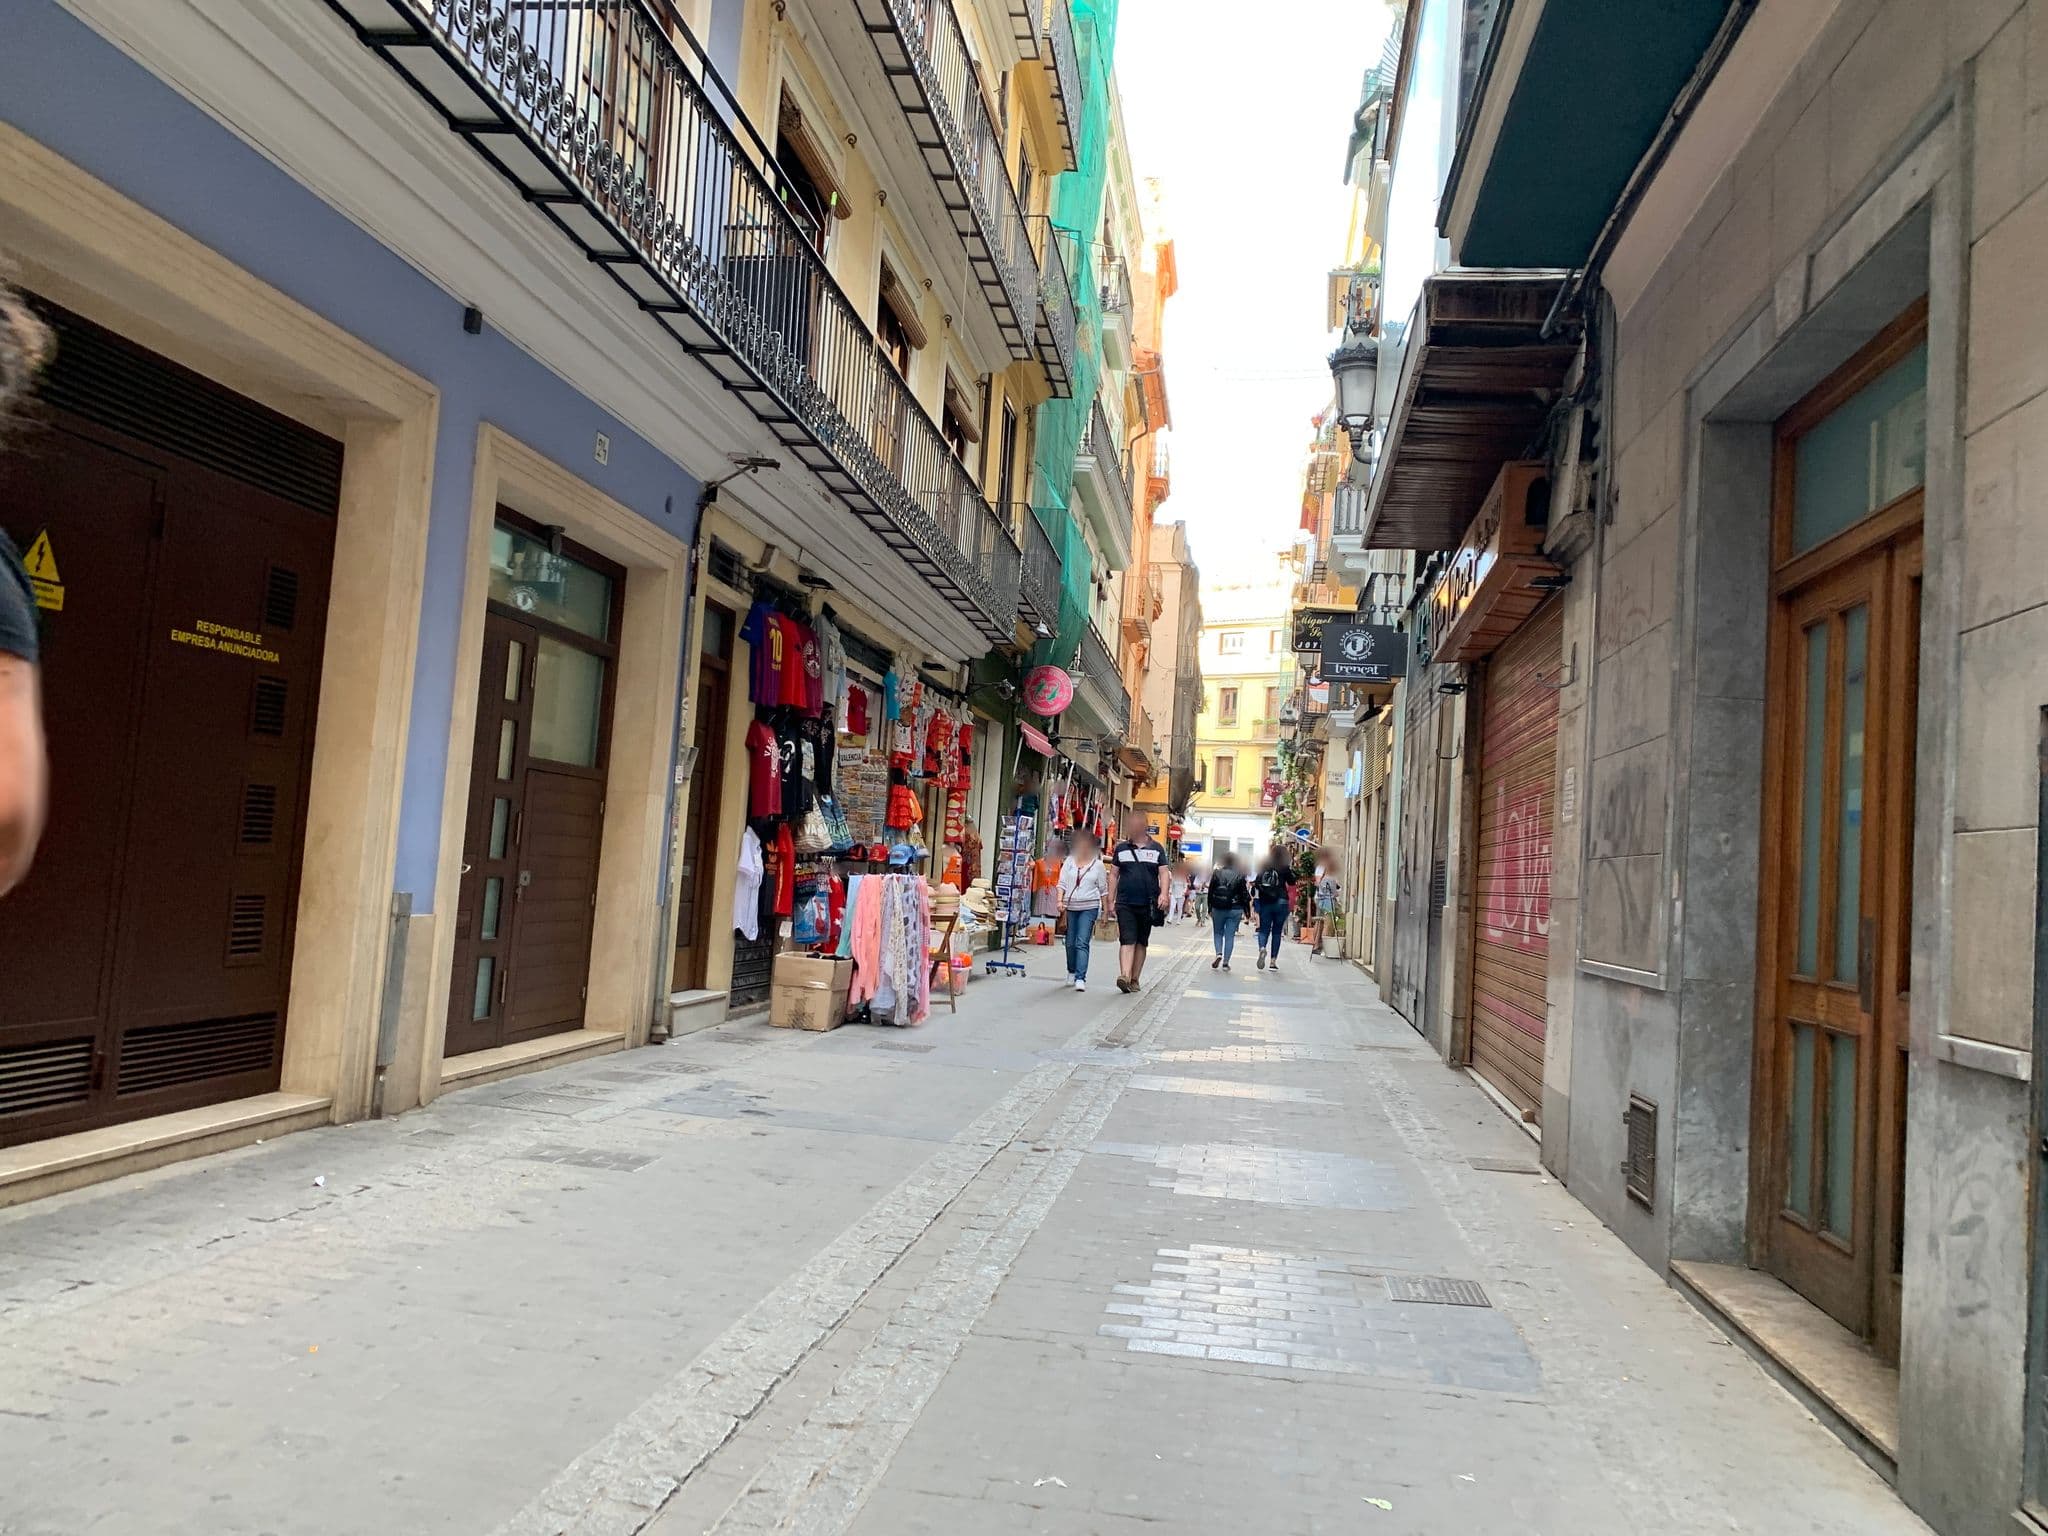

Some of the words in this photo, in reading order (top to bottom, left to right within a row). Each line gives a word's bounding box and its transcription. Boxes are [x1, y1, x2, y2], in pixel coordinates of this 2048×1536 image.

[171, 629, 216, 650] EMPRESA
[217, 641, 280, 664] ANUNCIADORA
[196, 620, 262, 645] RESPONSABLE
[769, 628, 783, 662] 10
